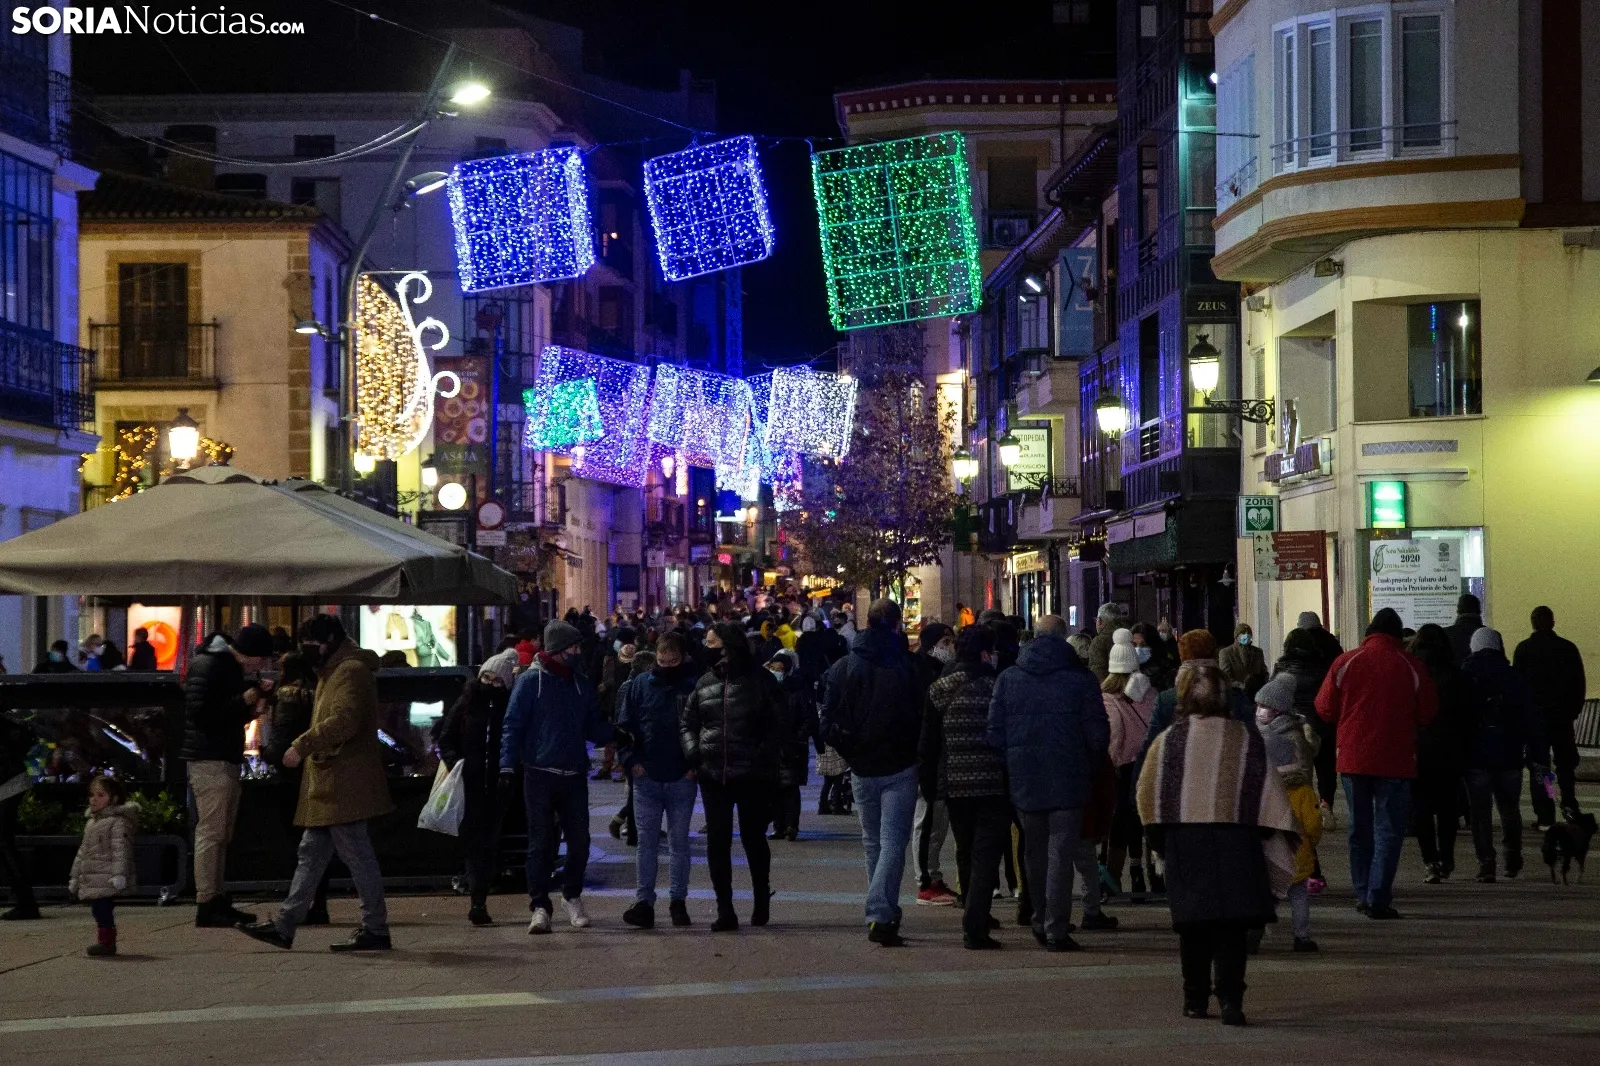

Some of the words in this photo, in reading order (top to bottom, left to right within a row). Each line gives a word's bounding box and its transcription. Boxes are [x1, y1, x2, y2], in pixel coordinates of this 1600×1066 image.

[1197, 301, 1227, 311] ZEUS
[440, 451, 477, 461] ASAJA
[1245, 497, 1274, 506] zona
[1400, 554, 1420, 563] 2020
[1438, 575, 1447, 583] del
[1408, 584, 1434, 592] Provincia
